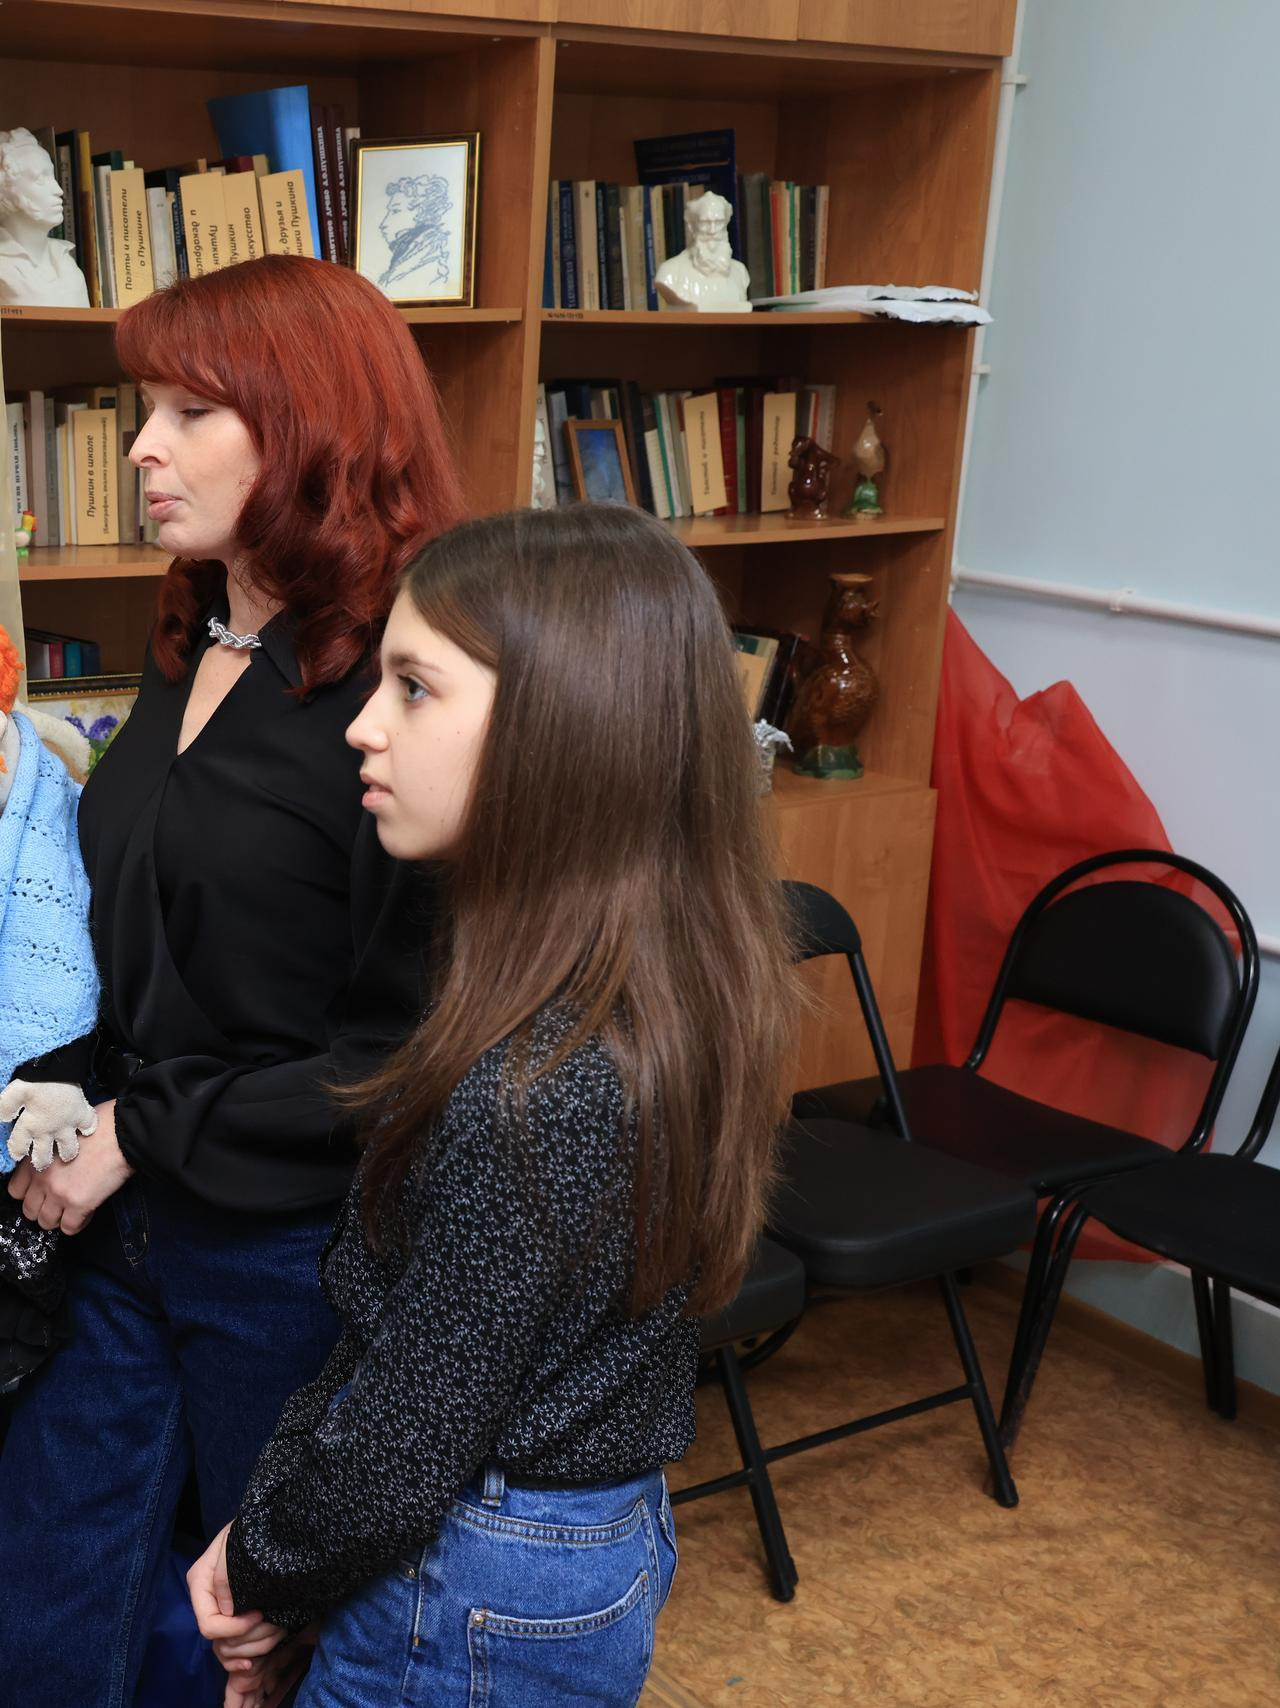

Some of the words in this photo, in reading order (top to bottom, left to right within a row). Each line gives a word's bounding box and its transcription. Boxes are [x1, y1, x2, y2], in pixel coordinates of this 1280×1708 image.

[287, 181, 300, 227] Пушкина
[136, 210, 145, 257] Пушкине
[209, 225, 219, 265] Пушкин
[229, 224, 238, 264] Пушкин
[277, 210, 288, 244] друзья
[122, 253, 132, 290] Поэты
[86, 479, 96, 517] Пушкин
